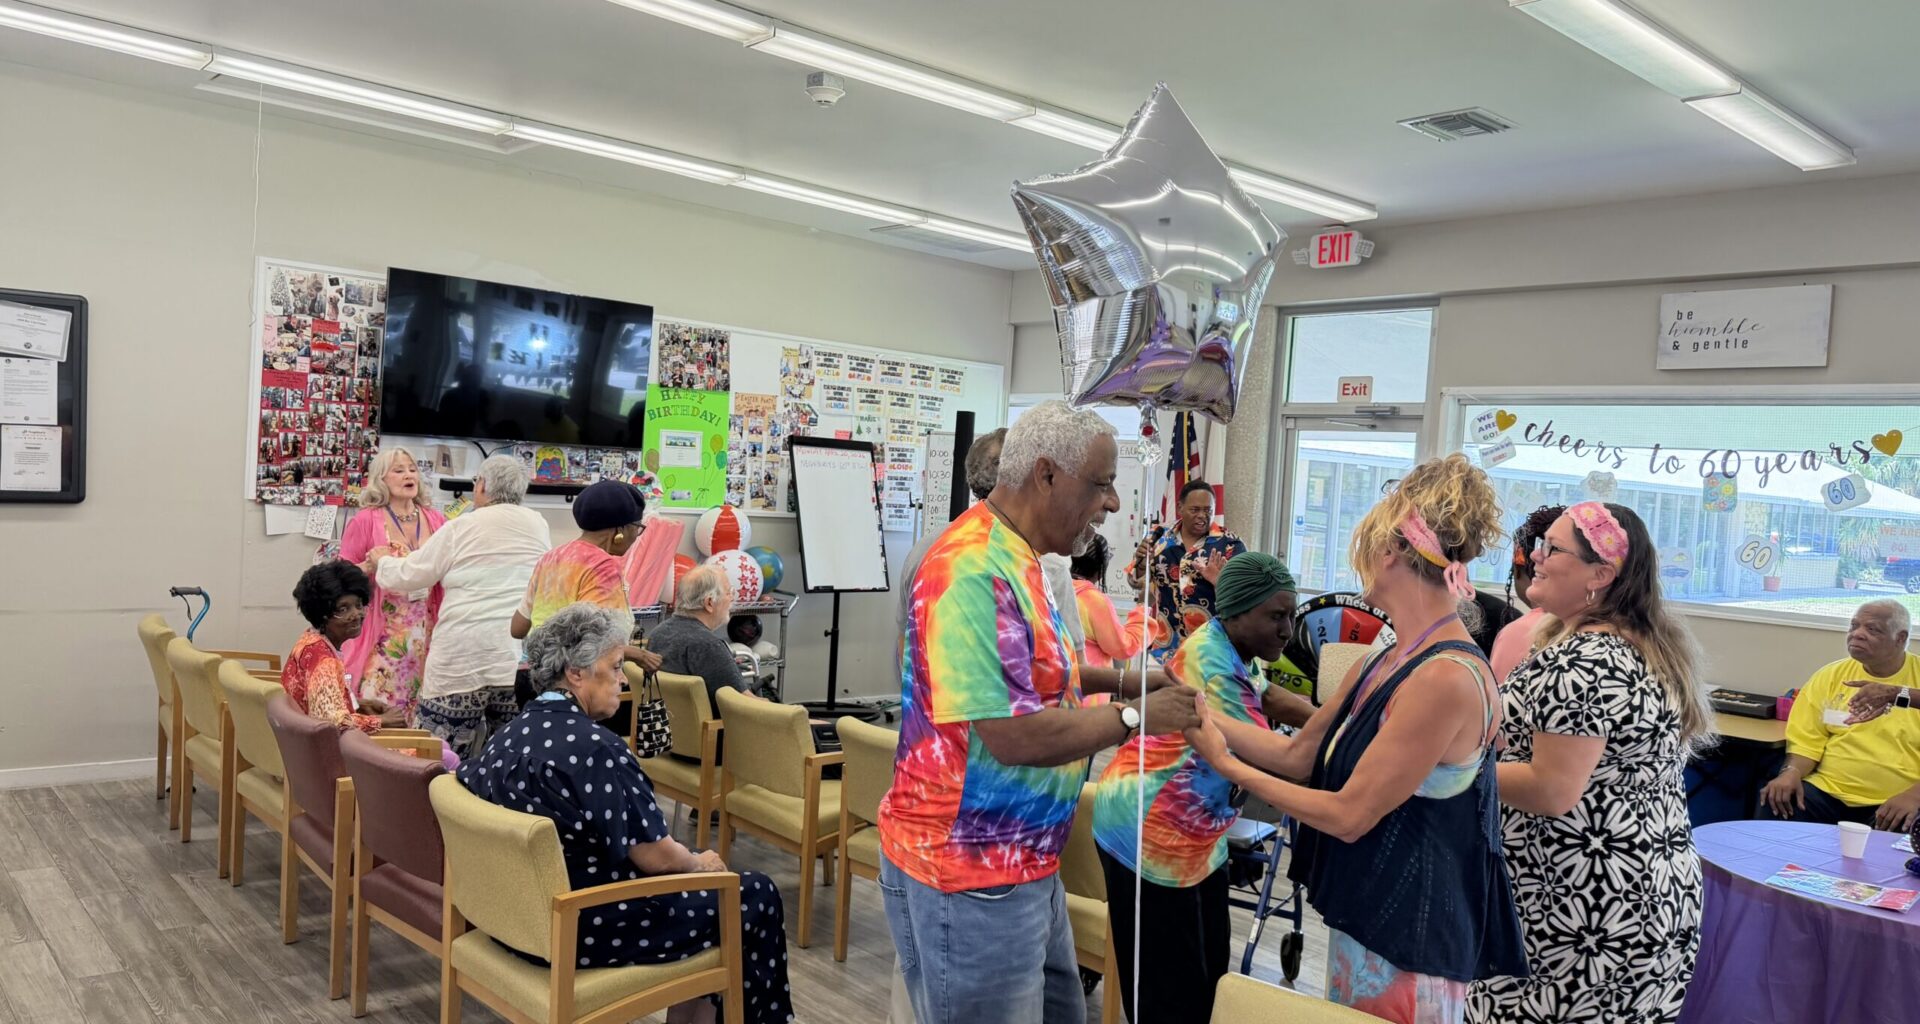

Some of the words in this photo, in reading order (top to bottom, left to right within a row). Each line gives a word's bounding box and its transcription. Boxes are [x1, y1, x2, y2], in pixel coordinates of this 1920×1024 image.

[1318, 233, 1352, 264] EXIT
[1677, 310, 1693, 320] be
[1668, 317, 1765, 337] humble
[1672, 340, 1680, 350] &
[1693, 338, 1748, 352] gentle
[661, 389, 706, 405] HAPPY
[1342, 383, 1367, 396] Exit
[647, 404, 721, 426] BIRTHDAY!
[1477, 413, 1493, 423] WE
[929, 449, 949, 458] 10:00
[1524, 419, 1627, 469] cheers
[1649, 443, 1686, 474] to
[1699, 449, 1741, 479] 60
[1754, 439, 1873, 489] years
[928, 470, 951, 479] 10:30
[1828, 477, 1856, 504] 60
[927, 494, 948, 503] 12:00
[1740, 541, 1772, 569] 60
